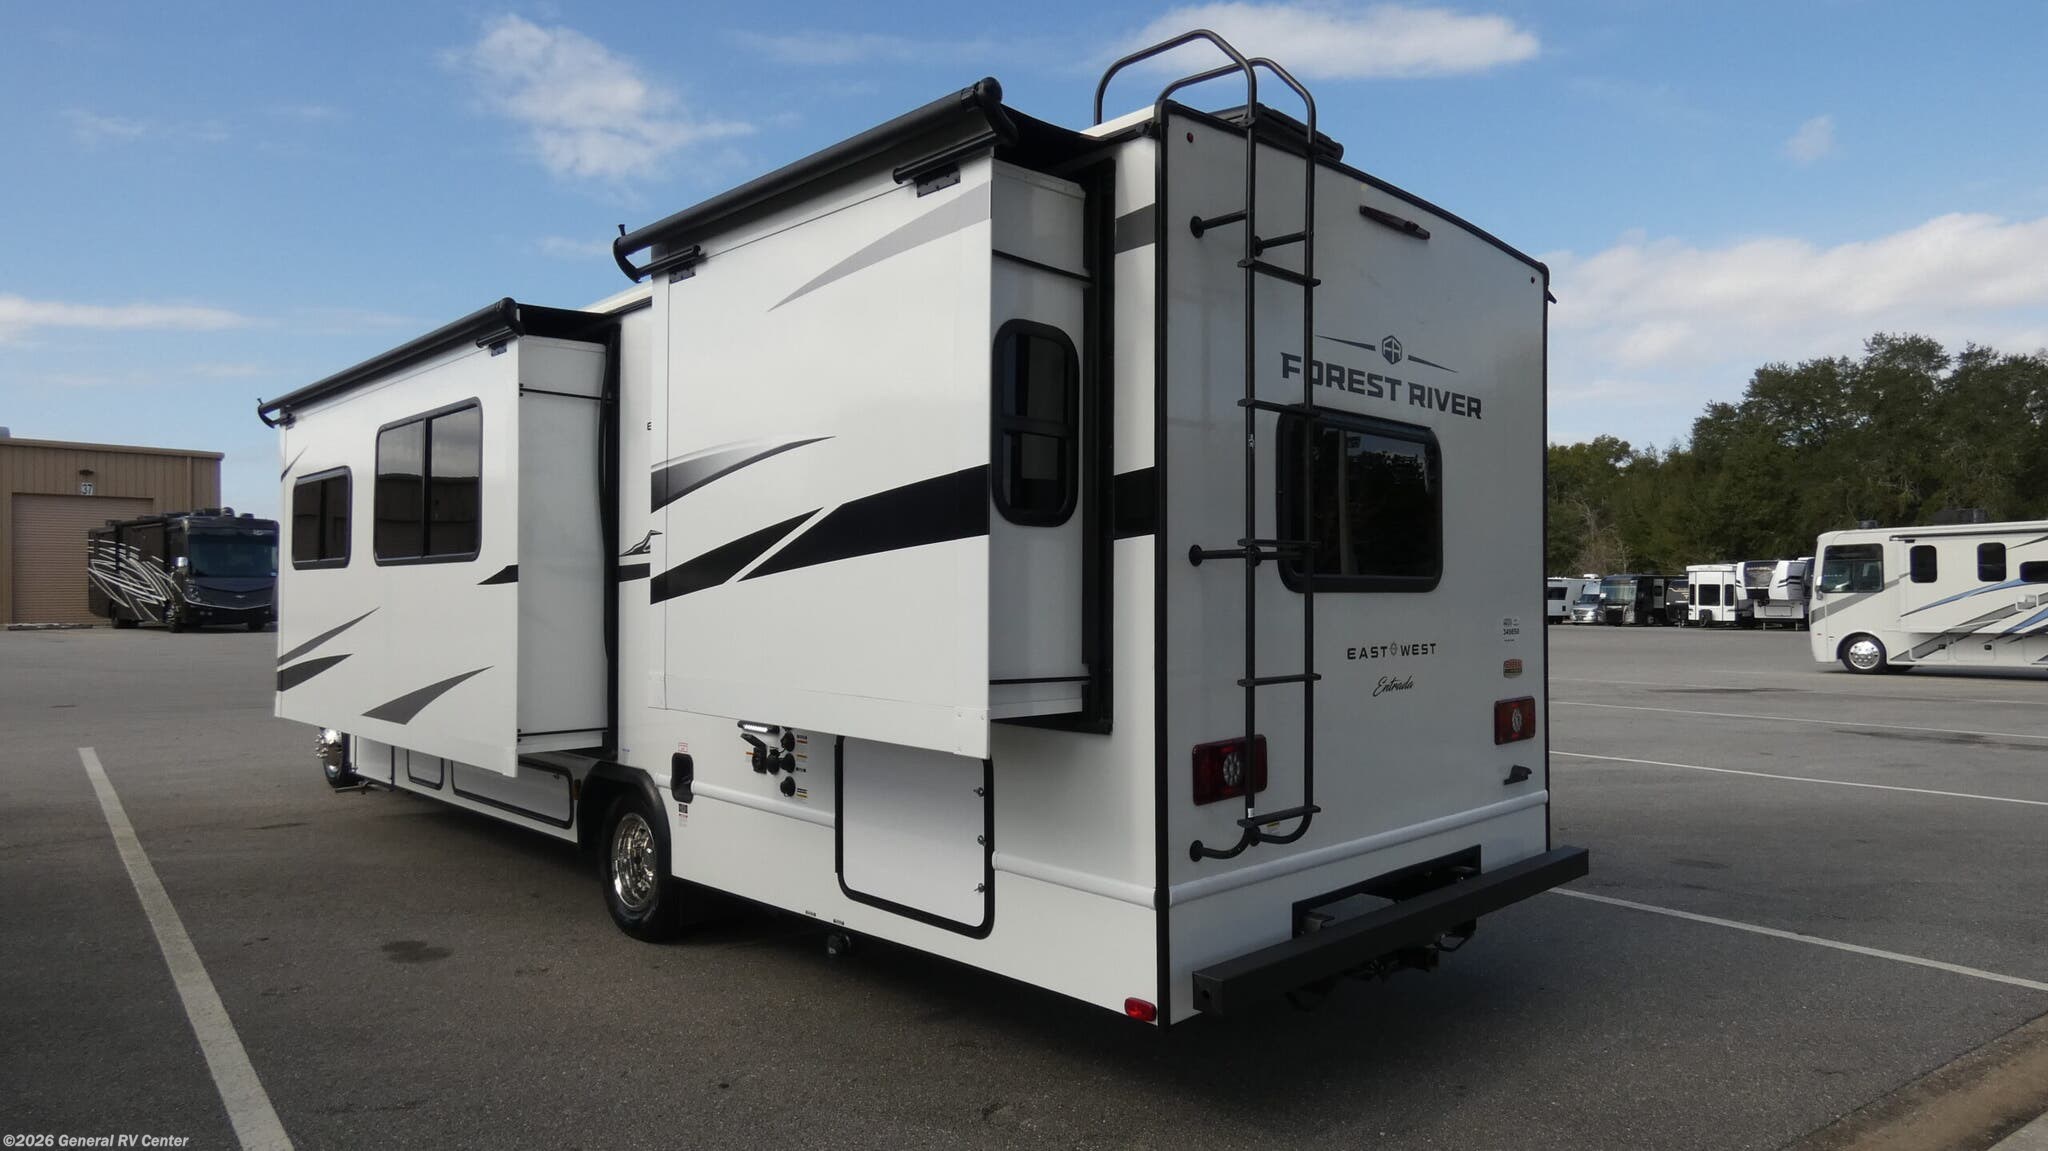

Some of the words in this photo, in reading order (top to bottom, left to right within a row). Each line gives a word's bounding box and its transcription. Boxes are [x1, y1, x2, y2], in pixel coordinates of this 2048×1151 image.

[1280, 352, 1402, 402] FOREST
[1407, 382, 1482, 420] RIVER
[1347, 645, 1388, 661] EAST
[1400, 643, 1437, 657] WEST
[1372, 675, 1415, 698] Entrada
